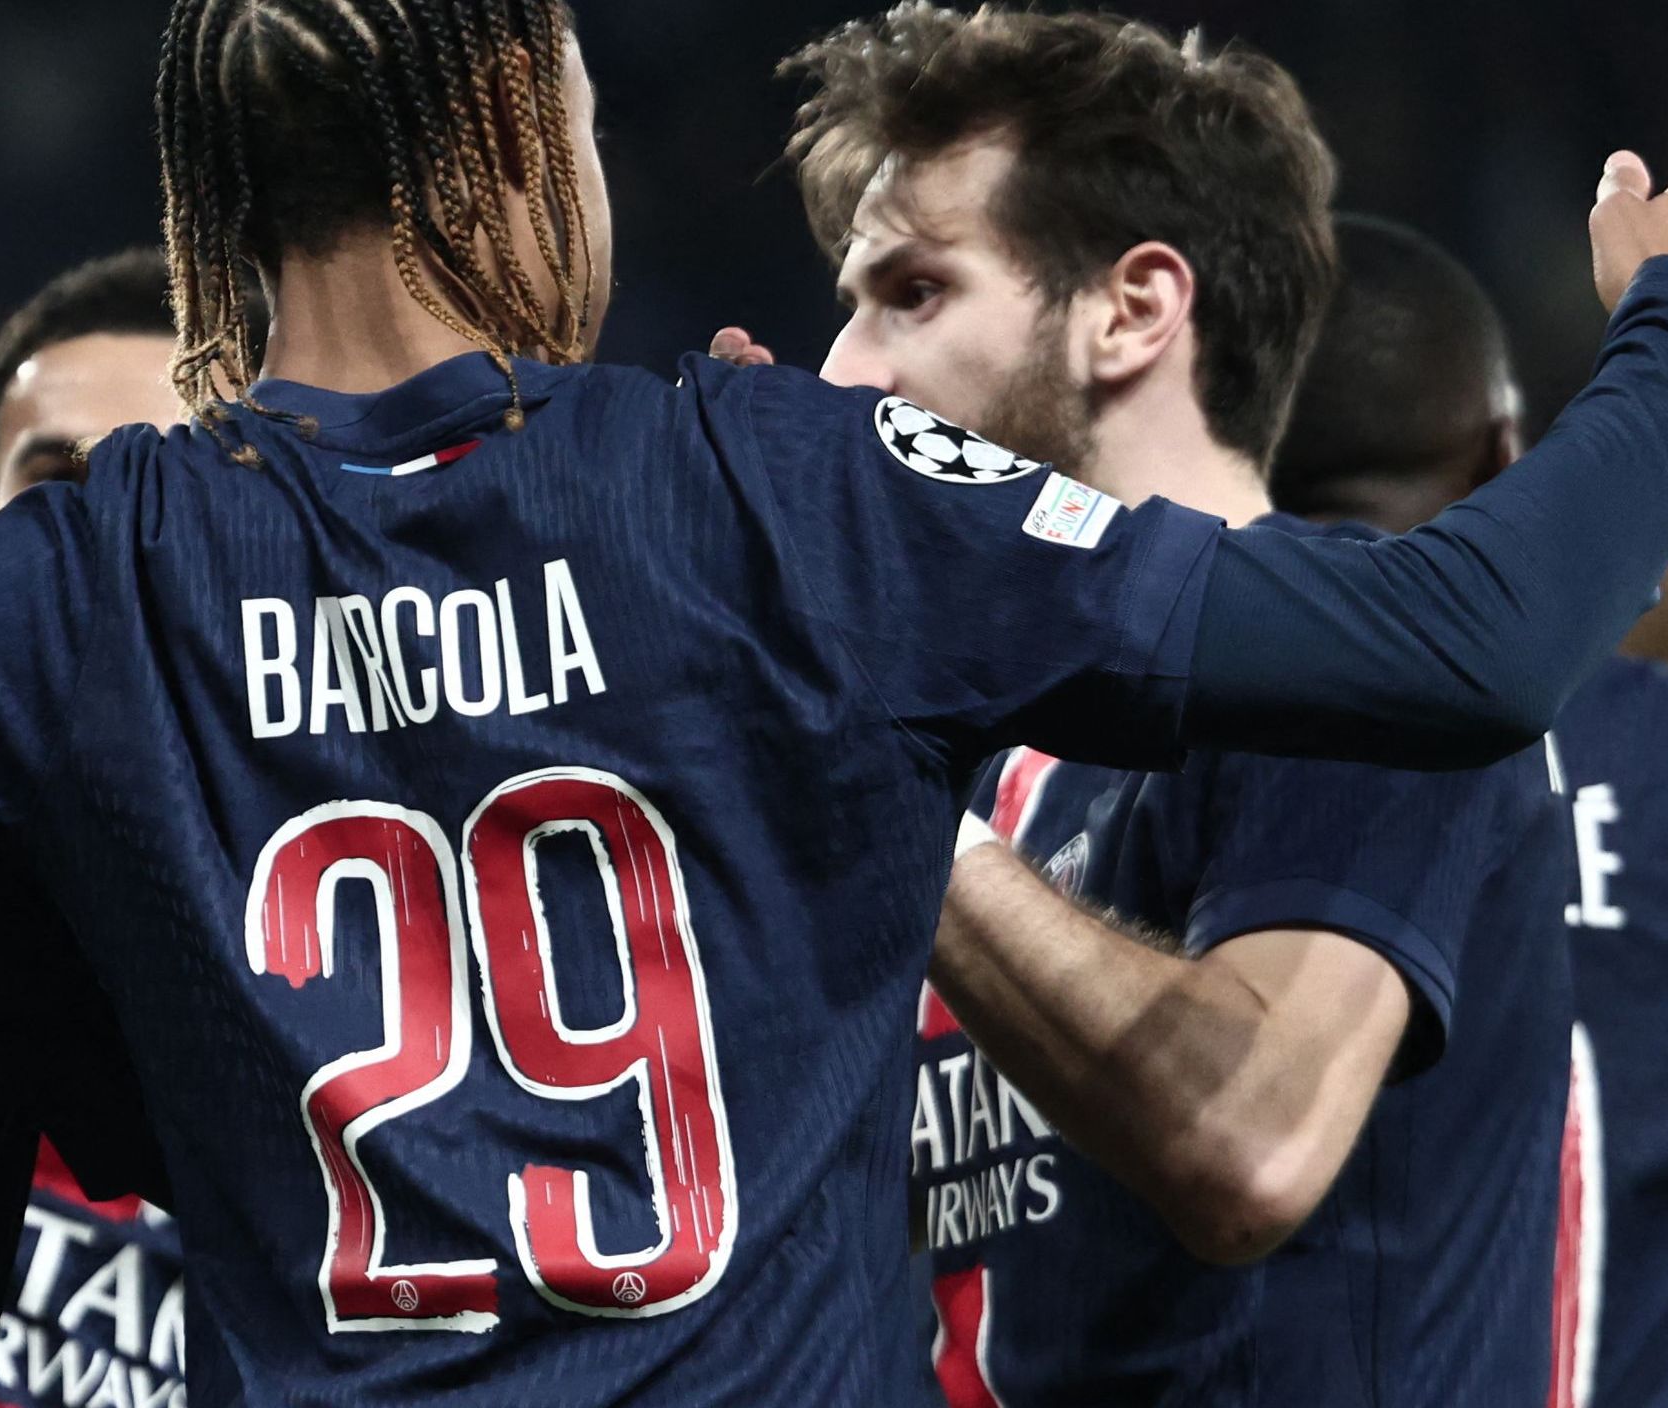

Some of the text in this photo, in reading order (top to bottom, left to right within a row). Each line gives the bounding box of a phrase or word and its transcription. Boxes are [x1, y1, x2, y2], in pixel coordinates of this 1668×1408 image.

[241, 558, 607, 739] BARCOLA
[1564, 783, 1626, 929] É
[245, 766, 738, 1334] 29
[926, 1153, 1062, 1250] IRWAYS
